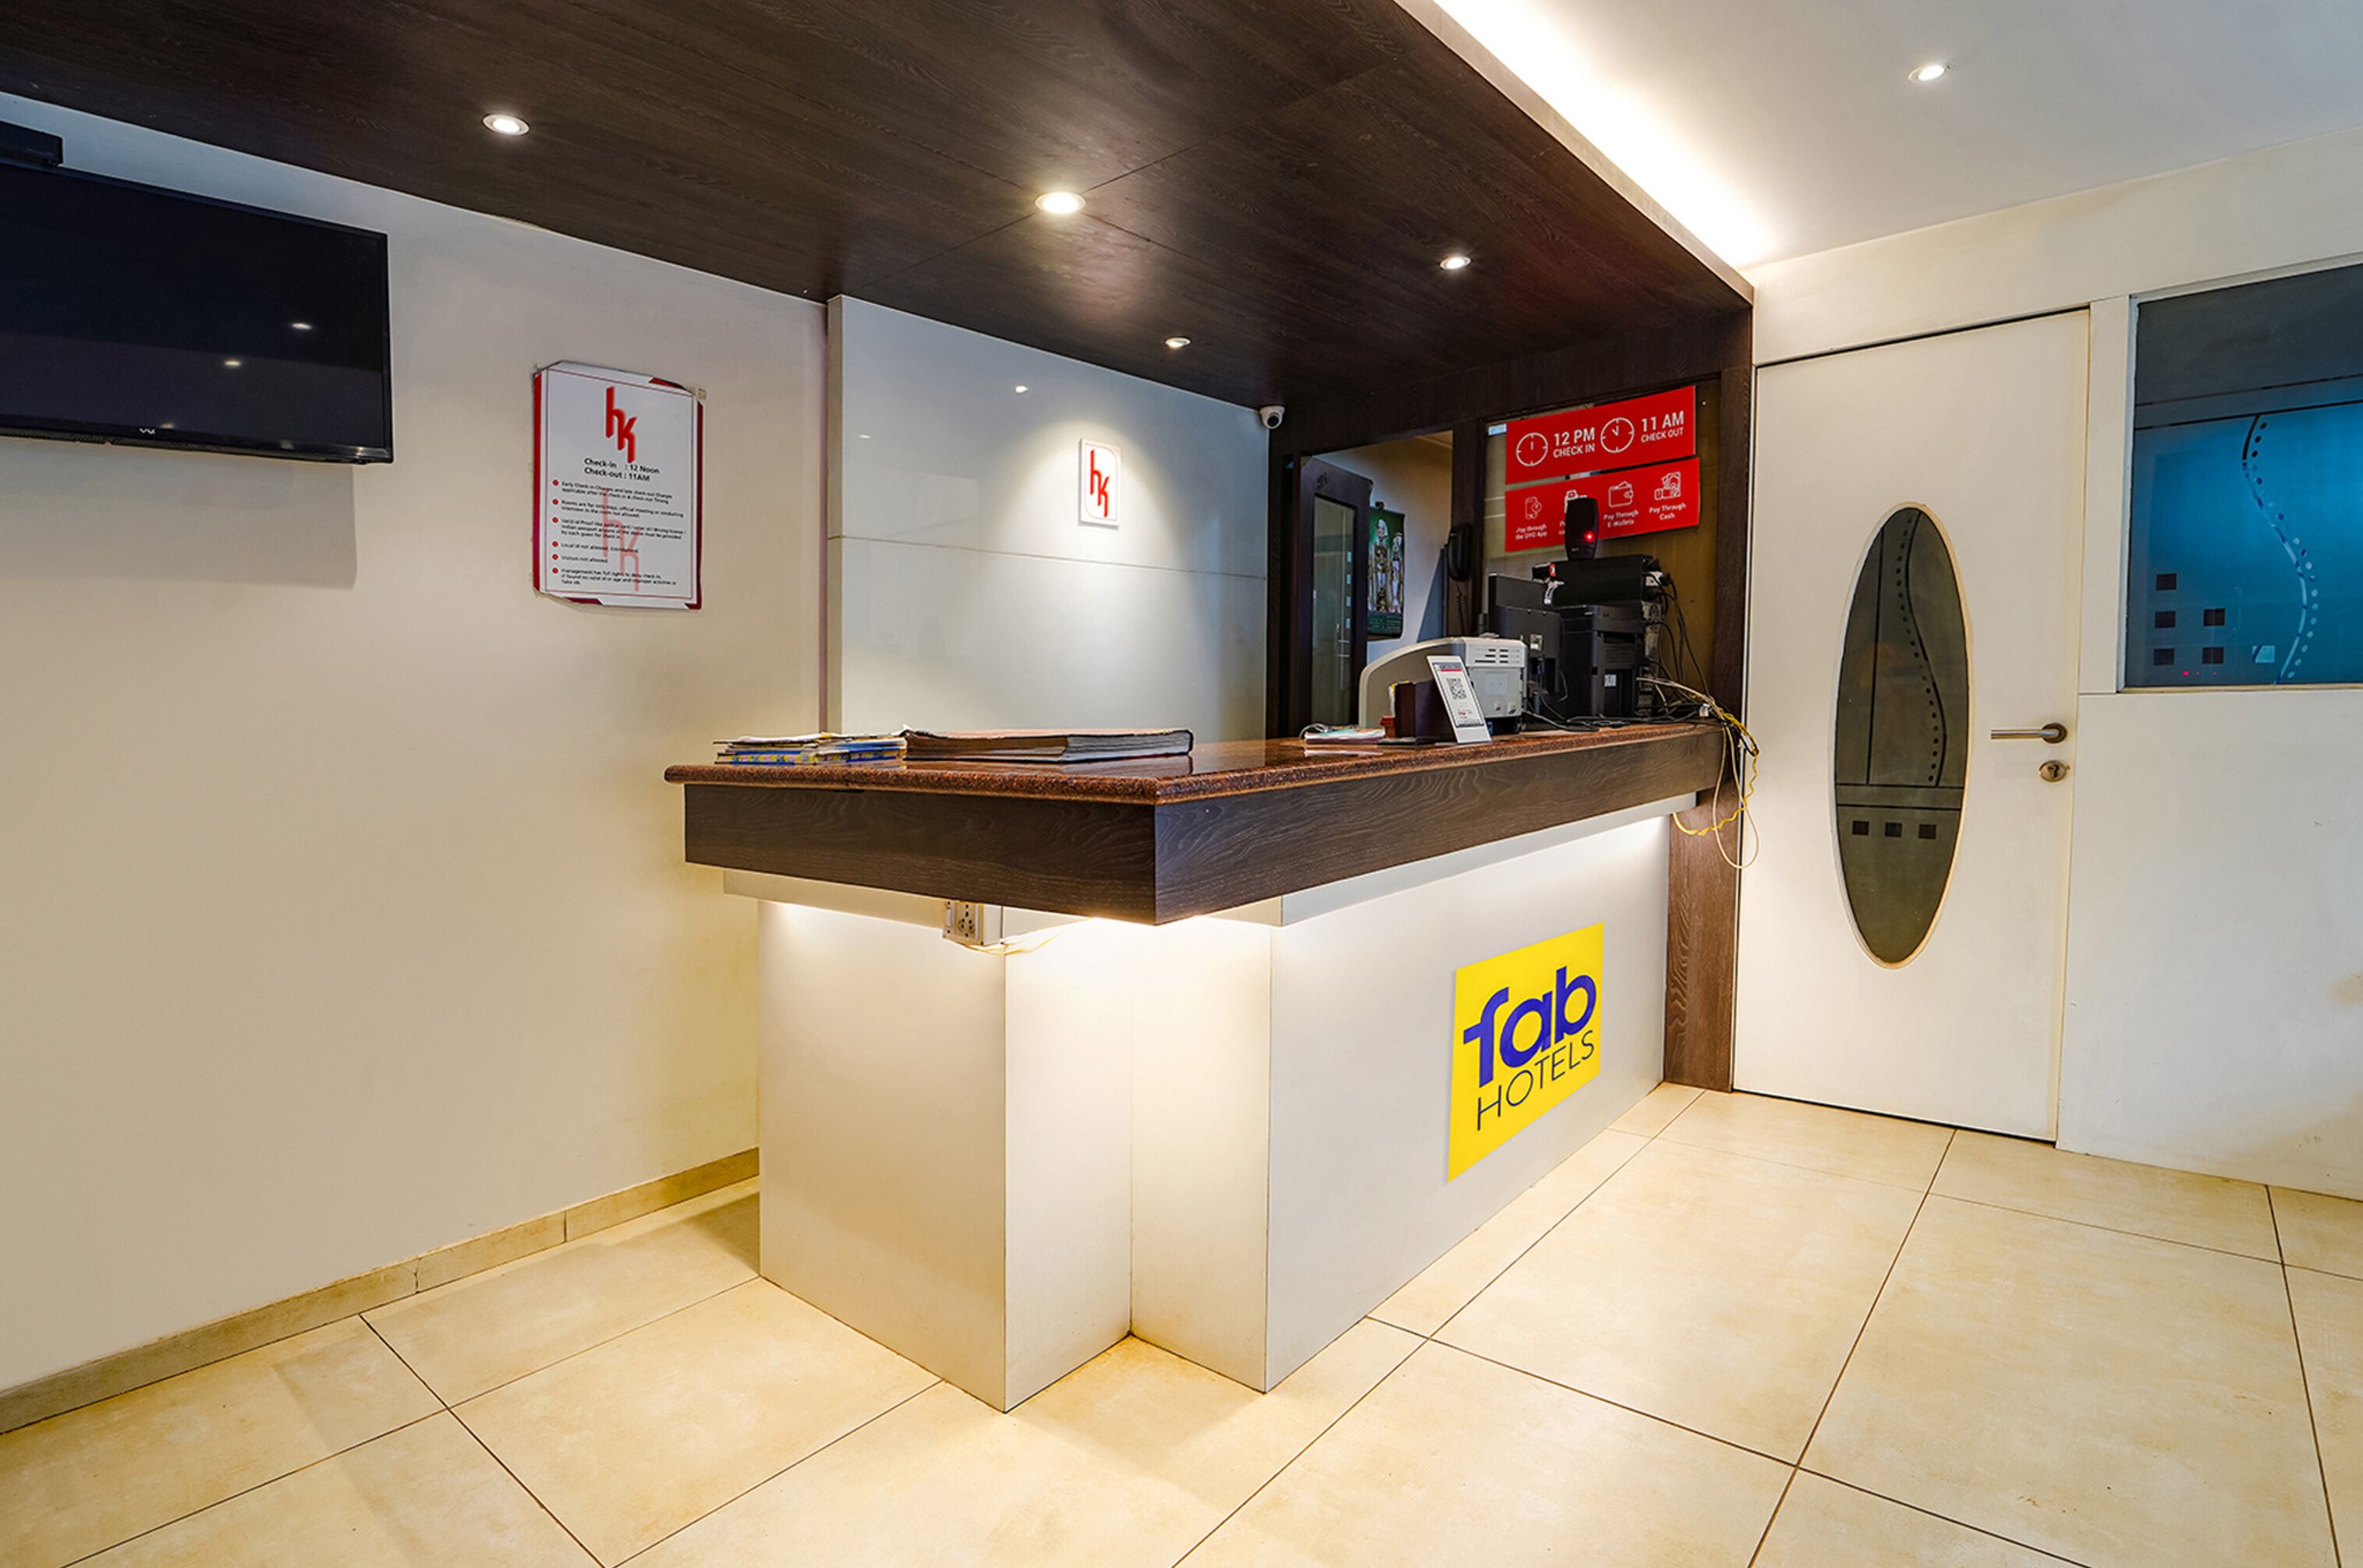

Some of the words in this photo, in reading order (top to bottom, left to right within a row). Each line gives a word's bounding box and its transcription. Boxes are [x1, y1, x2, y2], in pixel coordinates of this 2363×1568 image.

[1640, 416, 1656, 433] 11
[1661, 410, 1685, 429] AM
[1553, 430, 1570, 446] 12
[1573, 427, 1595, 443] PM
[1640, 430, 1667, 443] CHECK
[1667, 427, 1684, 438] OUT
[1553, 444, 1584, 458] CHECK
[1585, 443, 1596, 453] IN
[584, 457, 618, 468] Check-in
[639, 465, 660, 474] Noon
[584, 466, 622, 479] Check-out
[629, 473, 651, 482] 11AM
[1659, 511, 1676, 521] Cash
[1463, 965, 1596, 1088] fab
[1477, 1029, 1594, 1131] HOTELS
